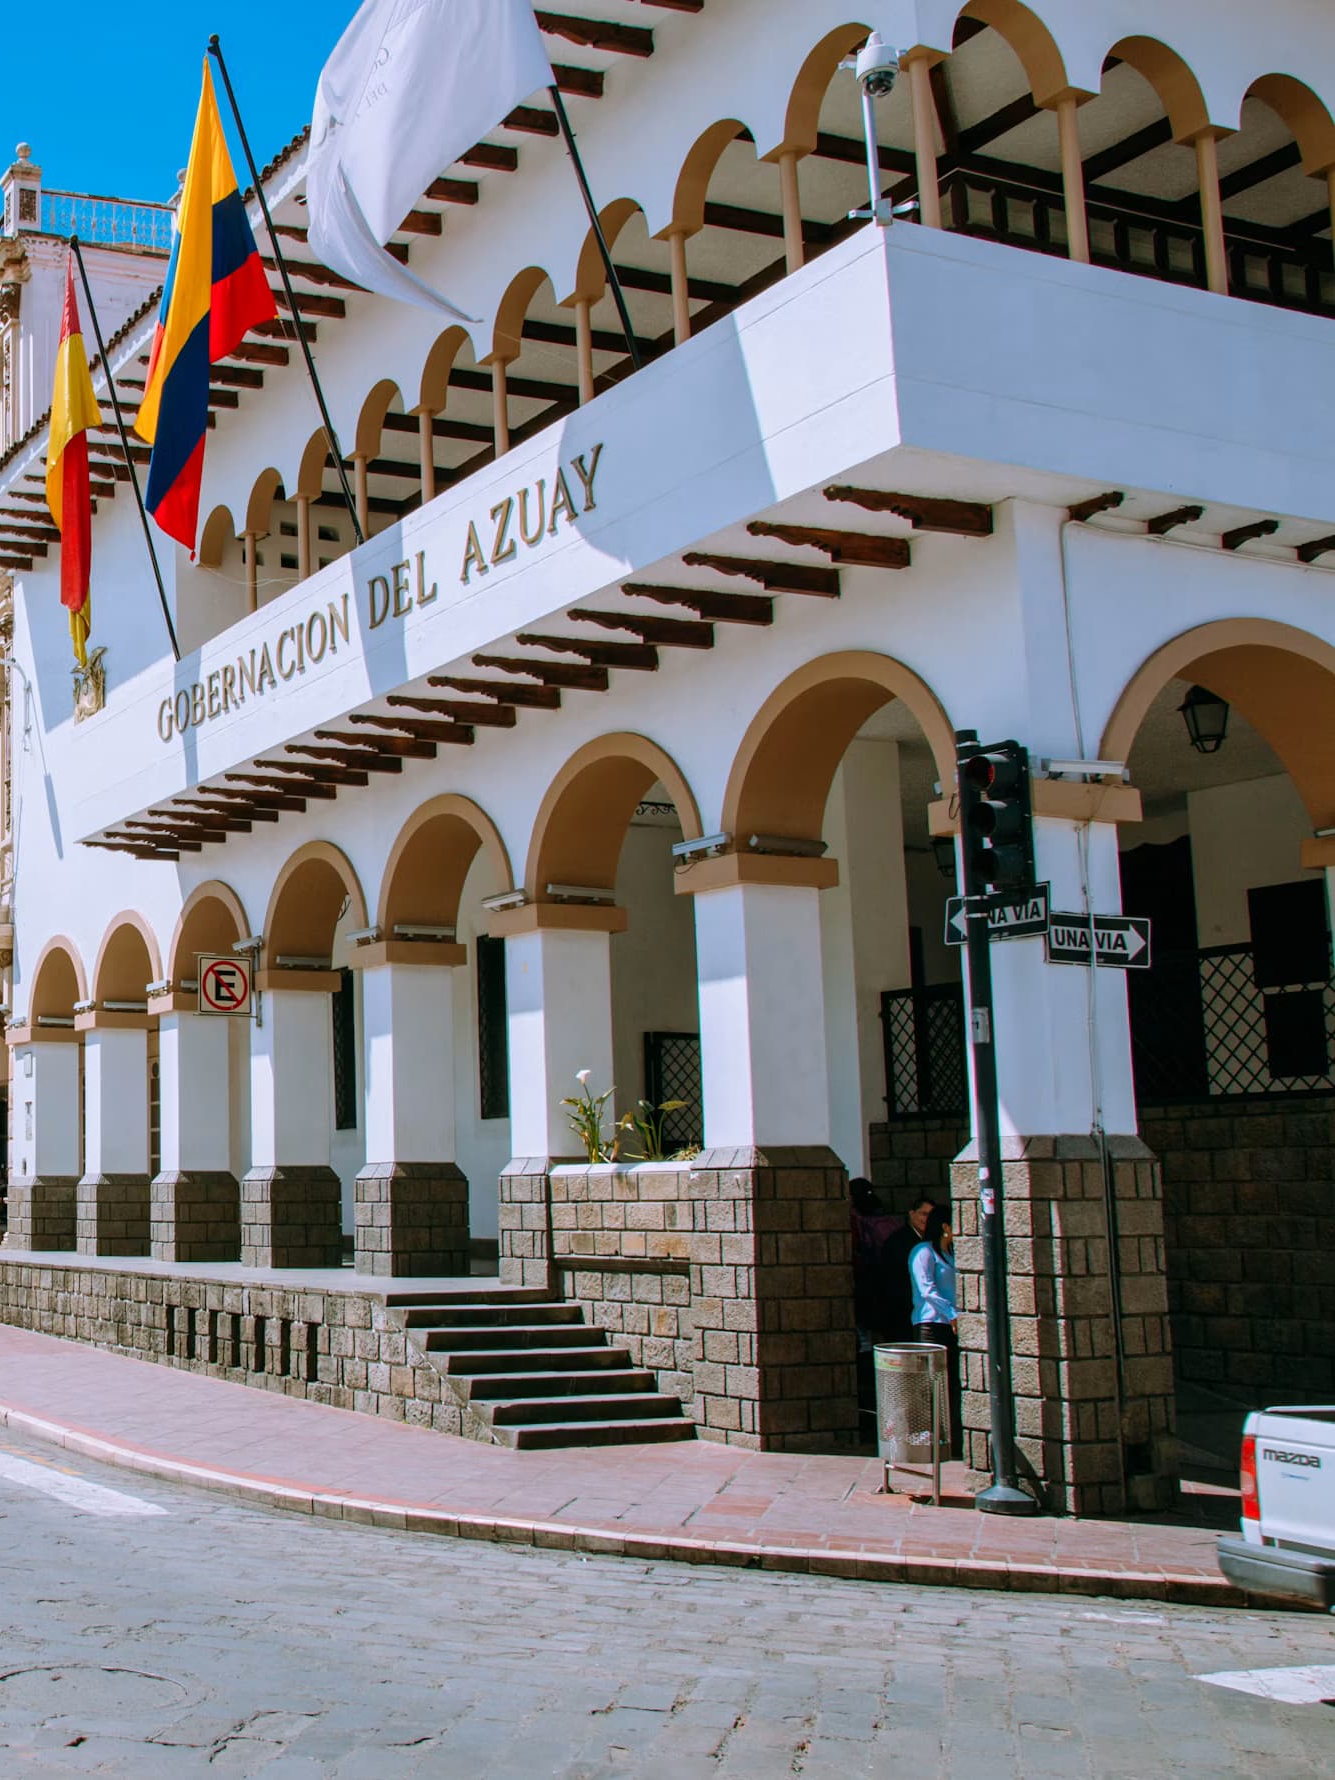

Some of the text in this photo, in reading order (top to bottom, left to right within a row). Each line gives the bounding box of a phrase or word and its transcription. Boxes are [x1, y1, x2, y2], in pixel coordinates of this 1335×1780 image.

[157, 443, 603, 743] GOBERNACION DEL AZUAY
[1012, 901, 1042, 921] VIA
[1054, 928, 1128, 950] UNA VIA
[215, 970, 238, 1001] E
[1262, 1448, 1321, 1468] mazda
